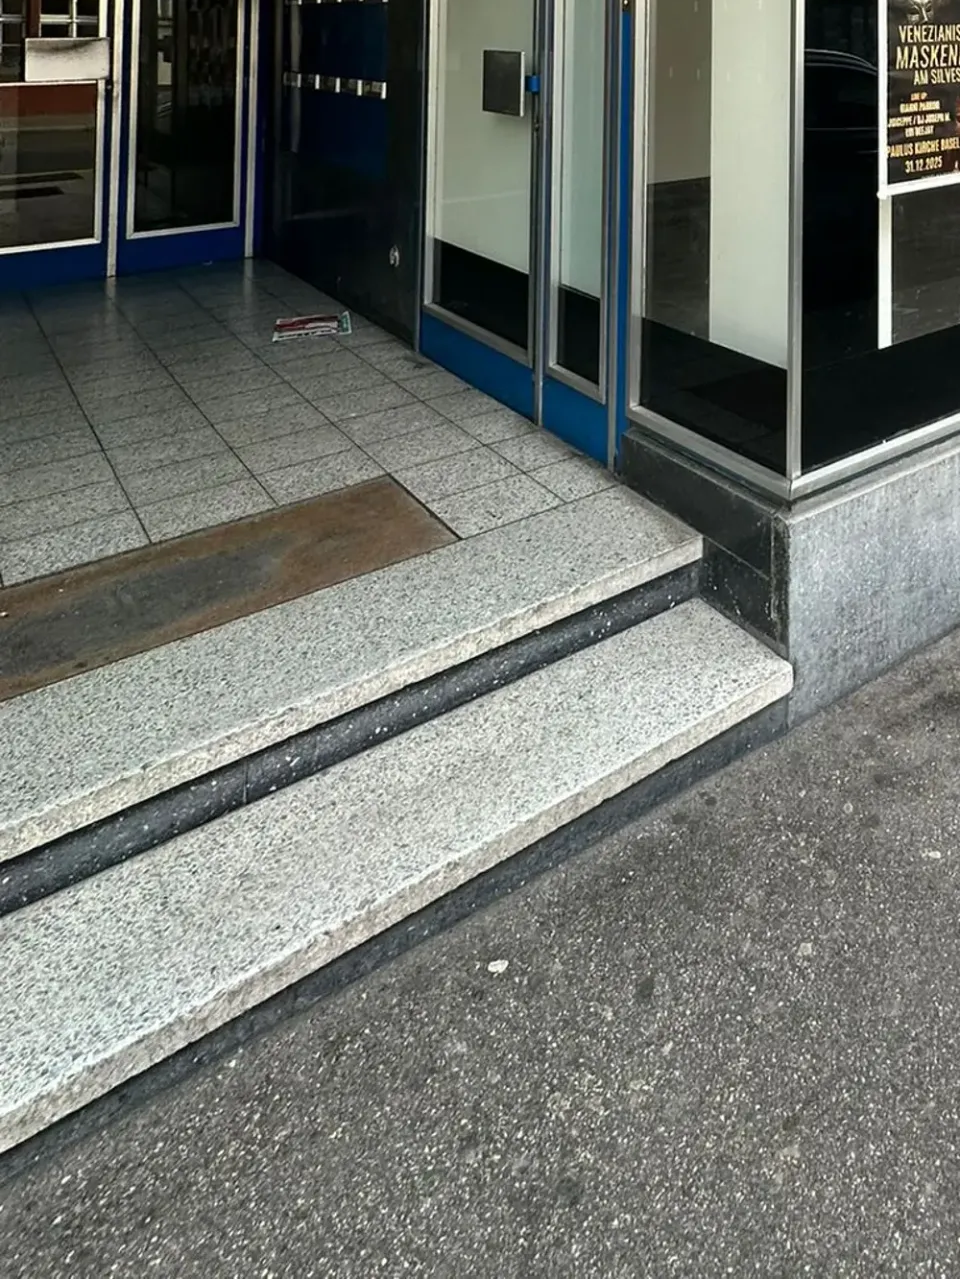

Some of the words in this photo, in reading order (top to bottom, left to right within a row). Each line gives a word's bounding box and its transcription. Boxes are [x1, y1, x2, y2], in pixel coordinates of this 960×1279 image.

[913, 70, 929, 86] AM
[886, 143, 913, 158] PAULUS
[915, 140, 939, 155] KIRCHE
[941, 137, 960, 150] BASEL
[905, 156, 943, 173] 31.12.2025
